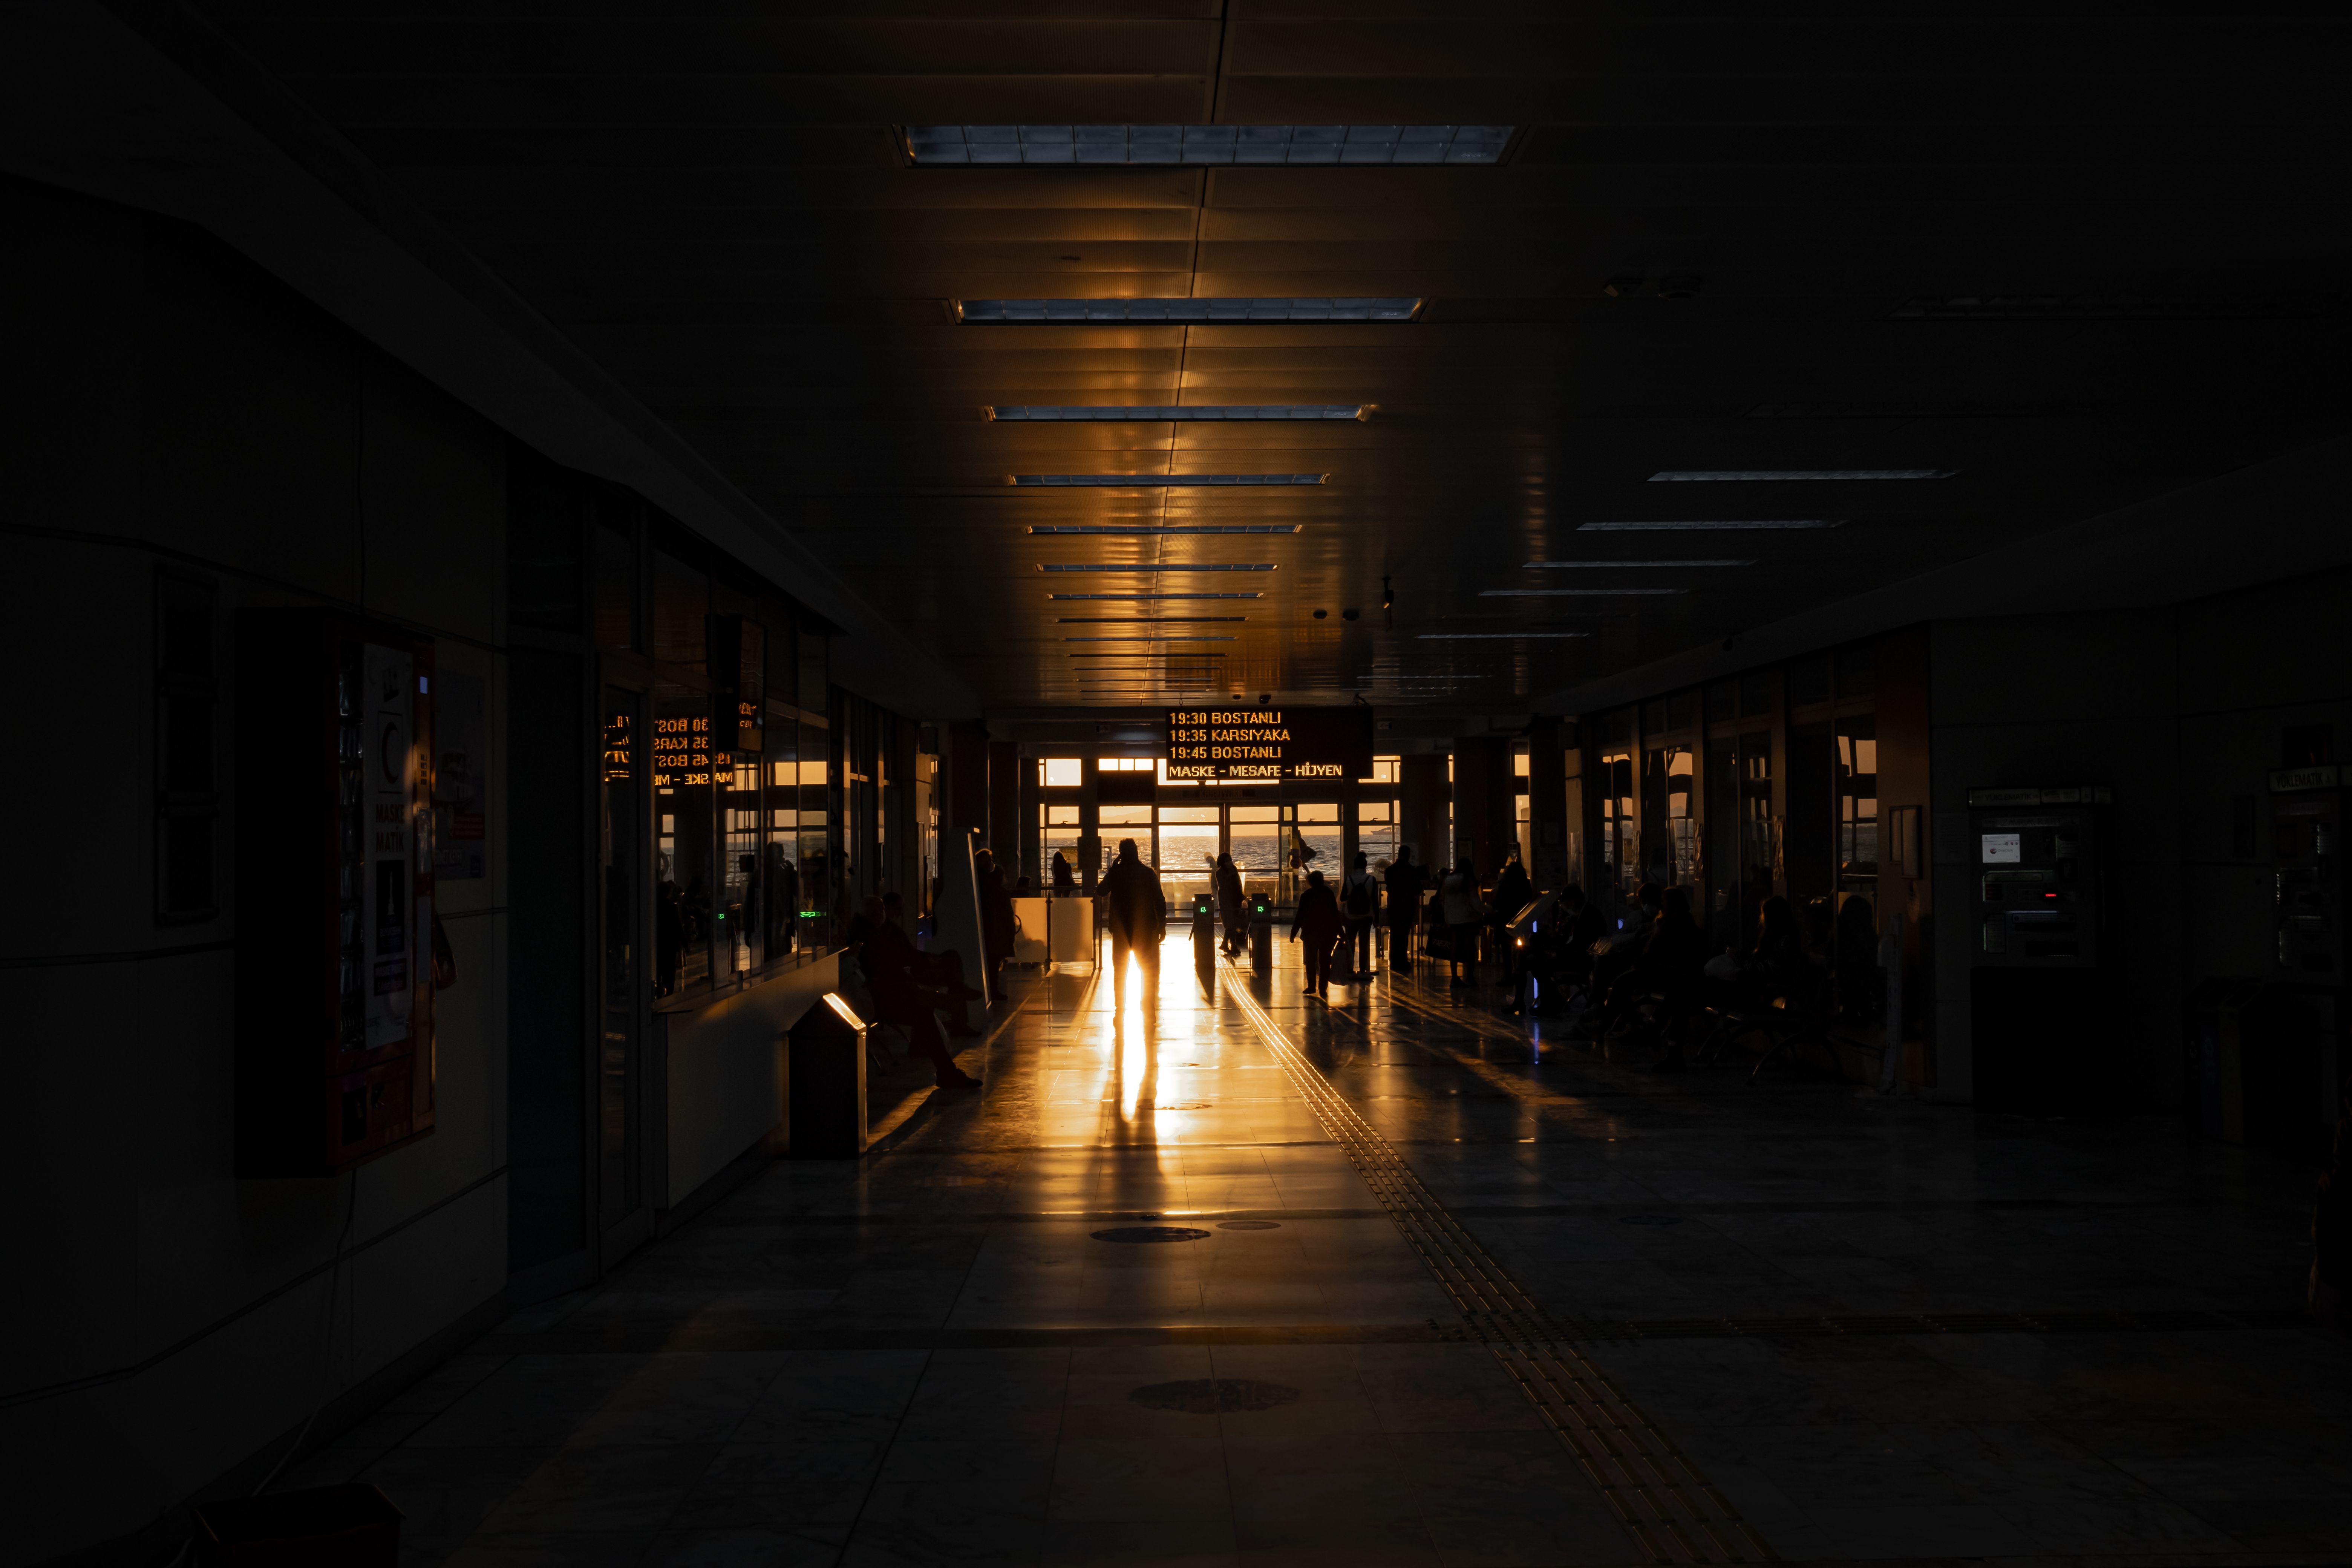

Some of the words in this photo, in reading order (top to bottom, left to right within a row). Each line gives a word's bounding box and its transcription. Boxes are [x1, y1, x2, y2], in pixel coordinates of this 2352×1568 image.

[1170, 713, 1207, 724] 19:30
[1212, 712, 1281, 724] BOSTANLI
[1170, 730, 1207, 741] 19:35
[1212, 729, 1290, 741] KARSIYAKA
[1170, 747, 1207, 758] 19:45
[1212, 746, 1281, 758] BOSTANLI
[1169, 766, 1216, 776] MASKE
[1230, 766, 1281, 776] MESAFE
[376, 803, 404, 824] MASKE
